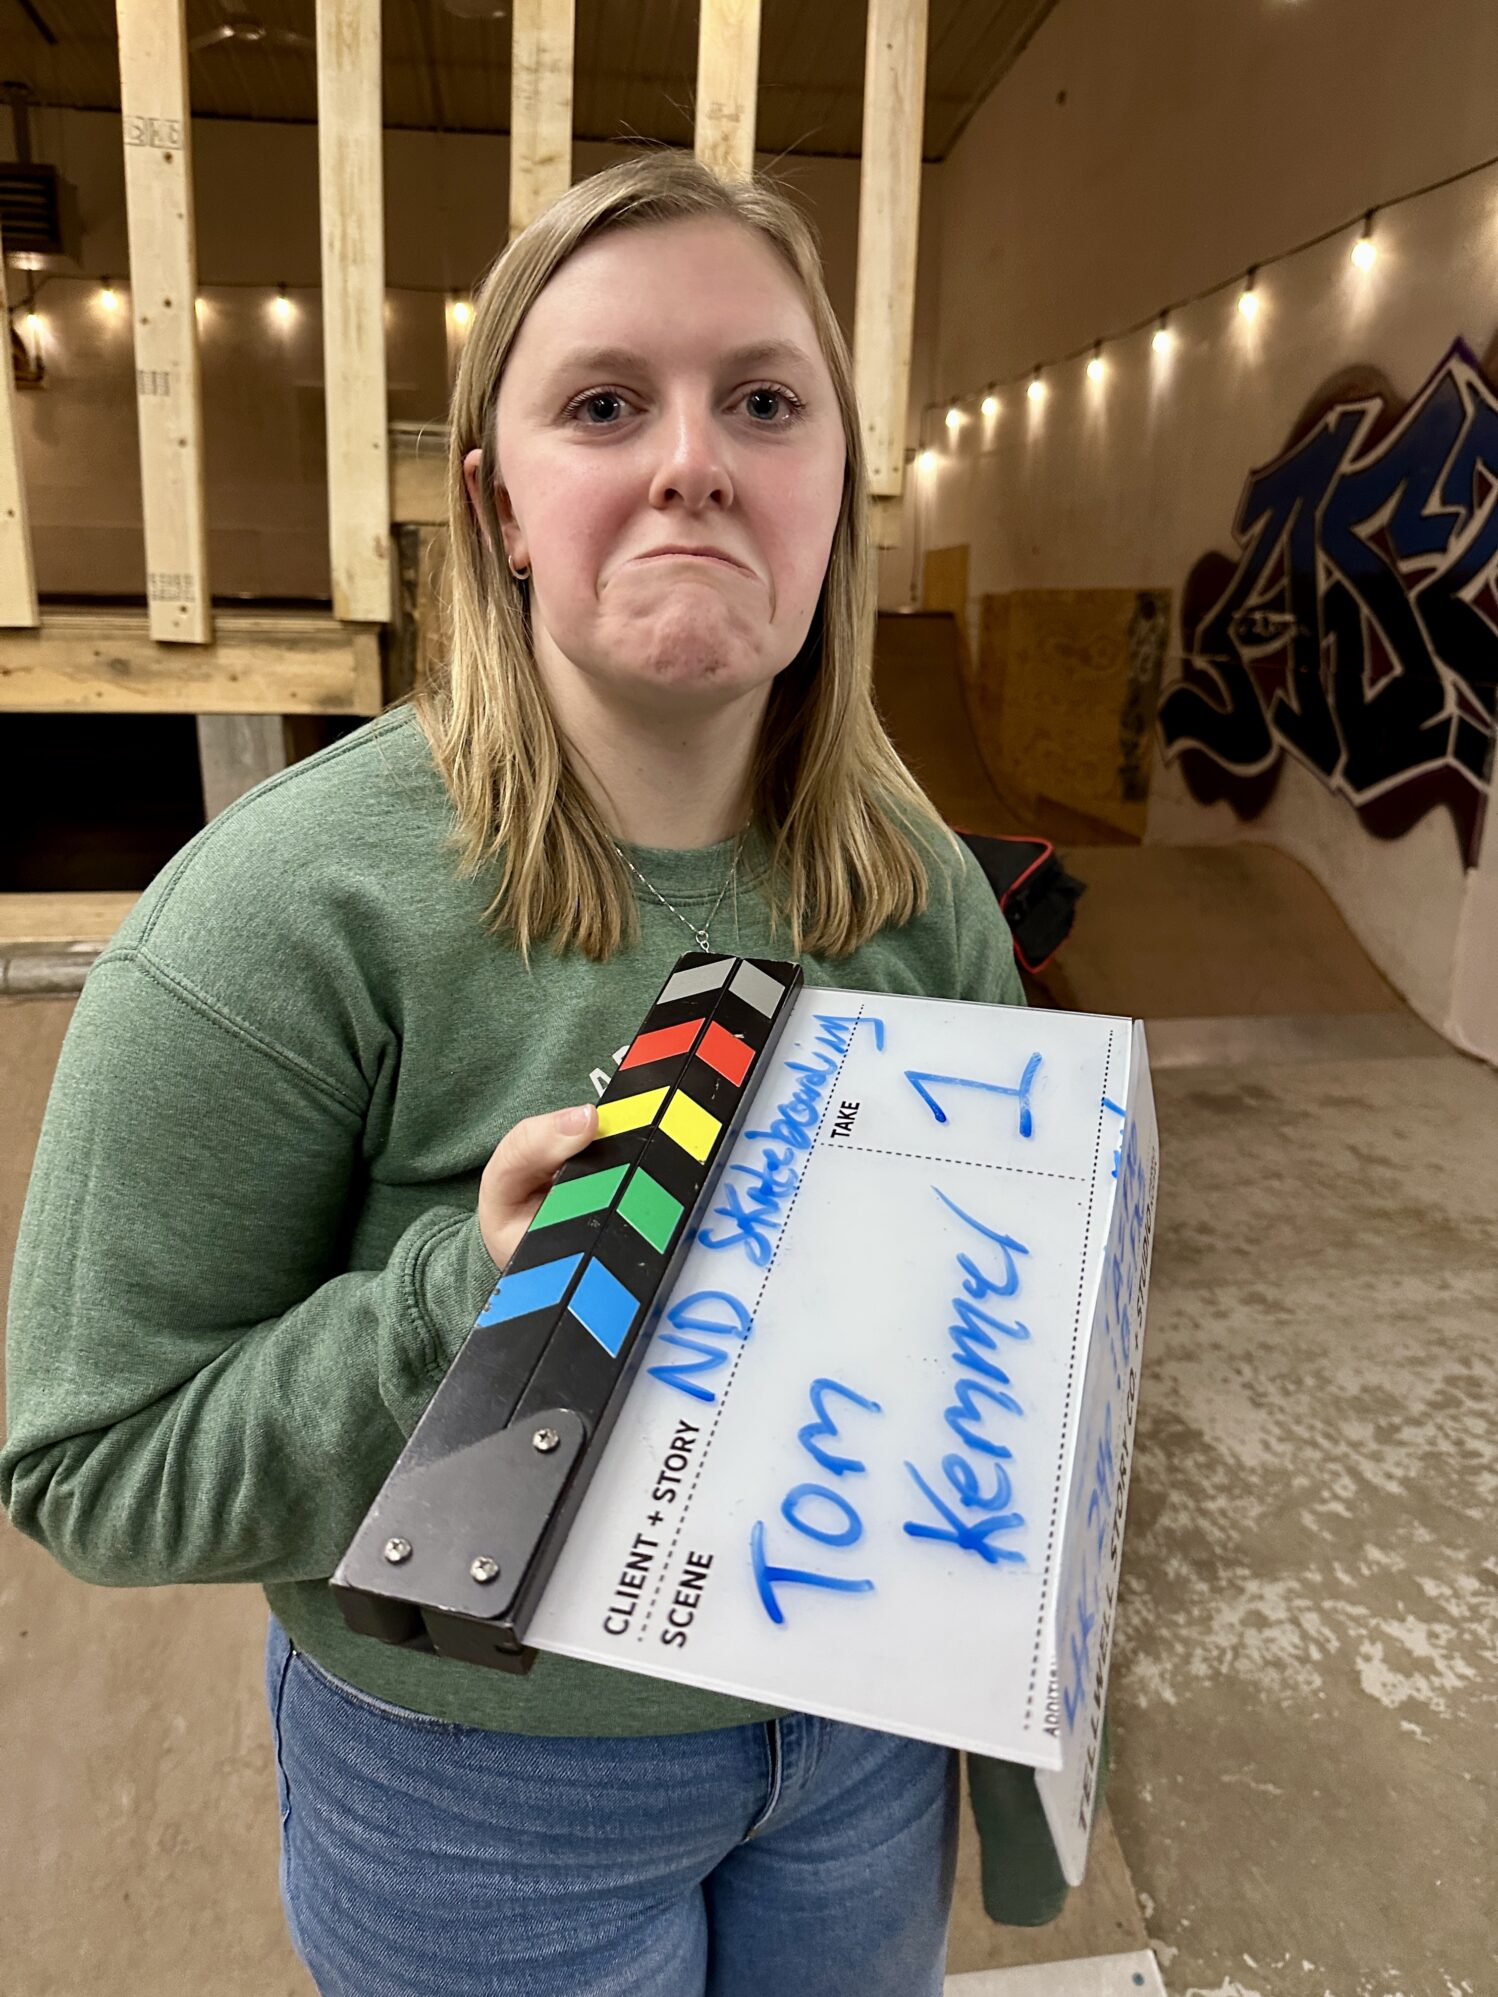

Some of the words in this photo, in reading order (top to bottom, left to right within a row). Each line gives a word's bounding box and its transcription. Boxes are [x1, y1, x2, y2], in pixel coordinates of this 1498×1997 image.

[830, 1100, 860, 1139] TAKE
[903, 1052, 1043, 1140] 1
[647, 1289, 756, 1405] ND
[651, 1419, 700, 1504] STORY
[647, 1510, 664, 1526] +
[603, 1532, 658, 1635] CLIENT
[660, 1550, 714, 1648] SCENE
[1078, 1581, 1115, 1834] TELLWELL
[1111, 1422, 1129, 1573] STORY
